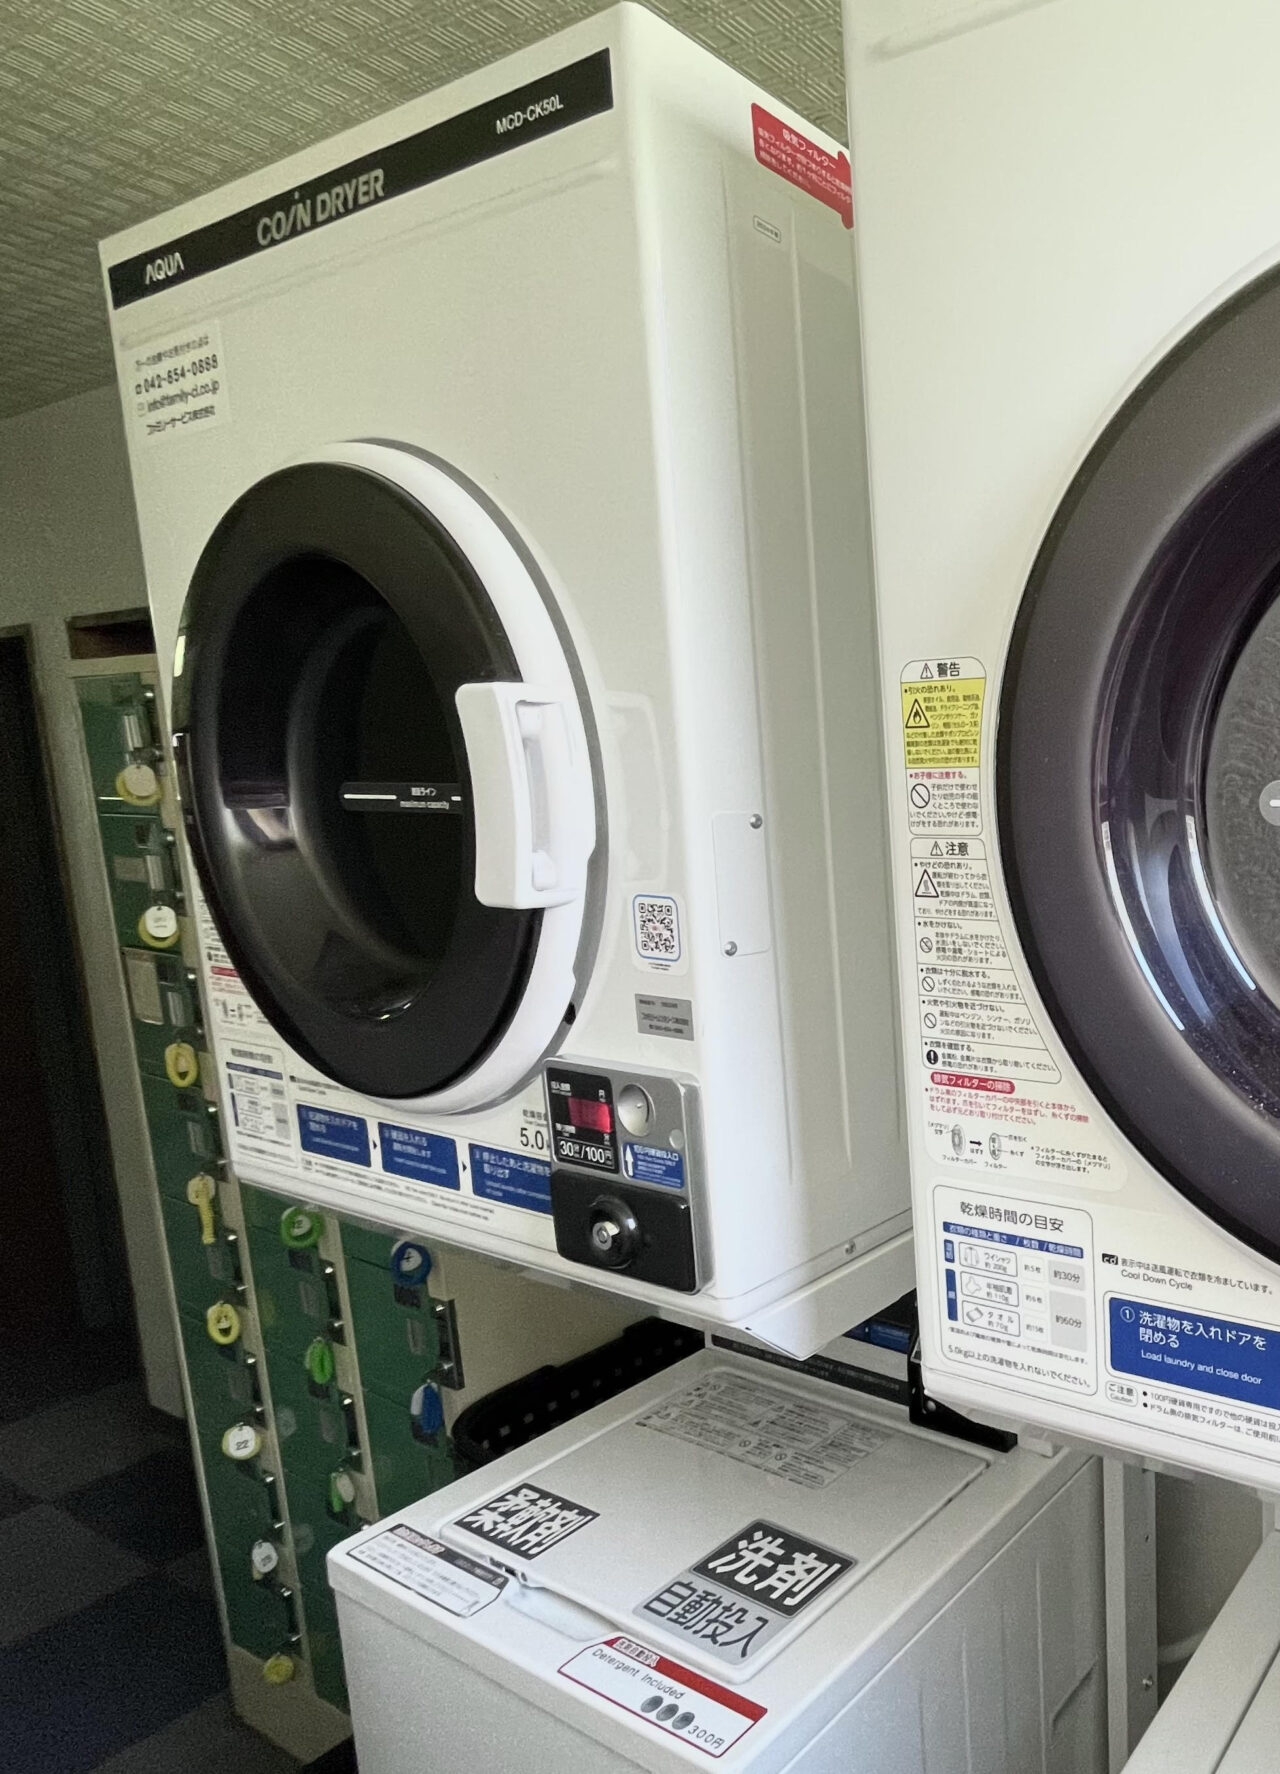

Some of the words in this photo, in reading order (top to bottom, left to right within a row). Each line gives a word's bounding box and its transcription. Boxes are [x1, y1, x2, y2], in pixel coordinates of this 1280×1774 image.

[496, 95, 564, 135] MCD-CK50L
[316, 168, 384, 222] DRYER
[144, 252, 184, 285] AQUA
[937, 662, 960, 678] 警告
[945, 842, 969, 856] 注意
[960, 1201, 1064, 1233] 乾燥時間の目安
[1053, 1270, 1081, 1283] 約30分
[1121, 1269, 1140, 1280] Cool
[1143, 1274, 1166, 1286] Down
[1168, 1278, 1193, 1291] Cycle
[1055, 1315, 1082, 1328] 約60分
[1139, 1309, 1267, 1351] 洗濯物を入れドアを
[1139, 1327, 1179, 1348] 閉める
[1141, 1350, 1162, 1362] Load
[1164, 1354, 1195, 1371] laundry
[1197, 1360, 1214, 1374] and
[1216, 1365, 1239, 1380] close
[1241, 1370, 1262, 1385] door
[1109, 1383, 1134, 1397] ご注意
[467, 1488, 593, 1555] 柔軟剤
[707, 1530, 842, 1606] 洗剤
[643, 1580, 770, 1659] 自動投入
[592, 1648, 640, 1677] Detergent
[640, 1674, 686, 1700] Included
[687, 1725, 726, 1750] 300円
